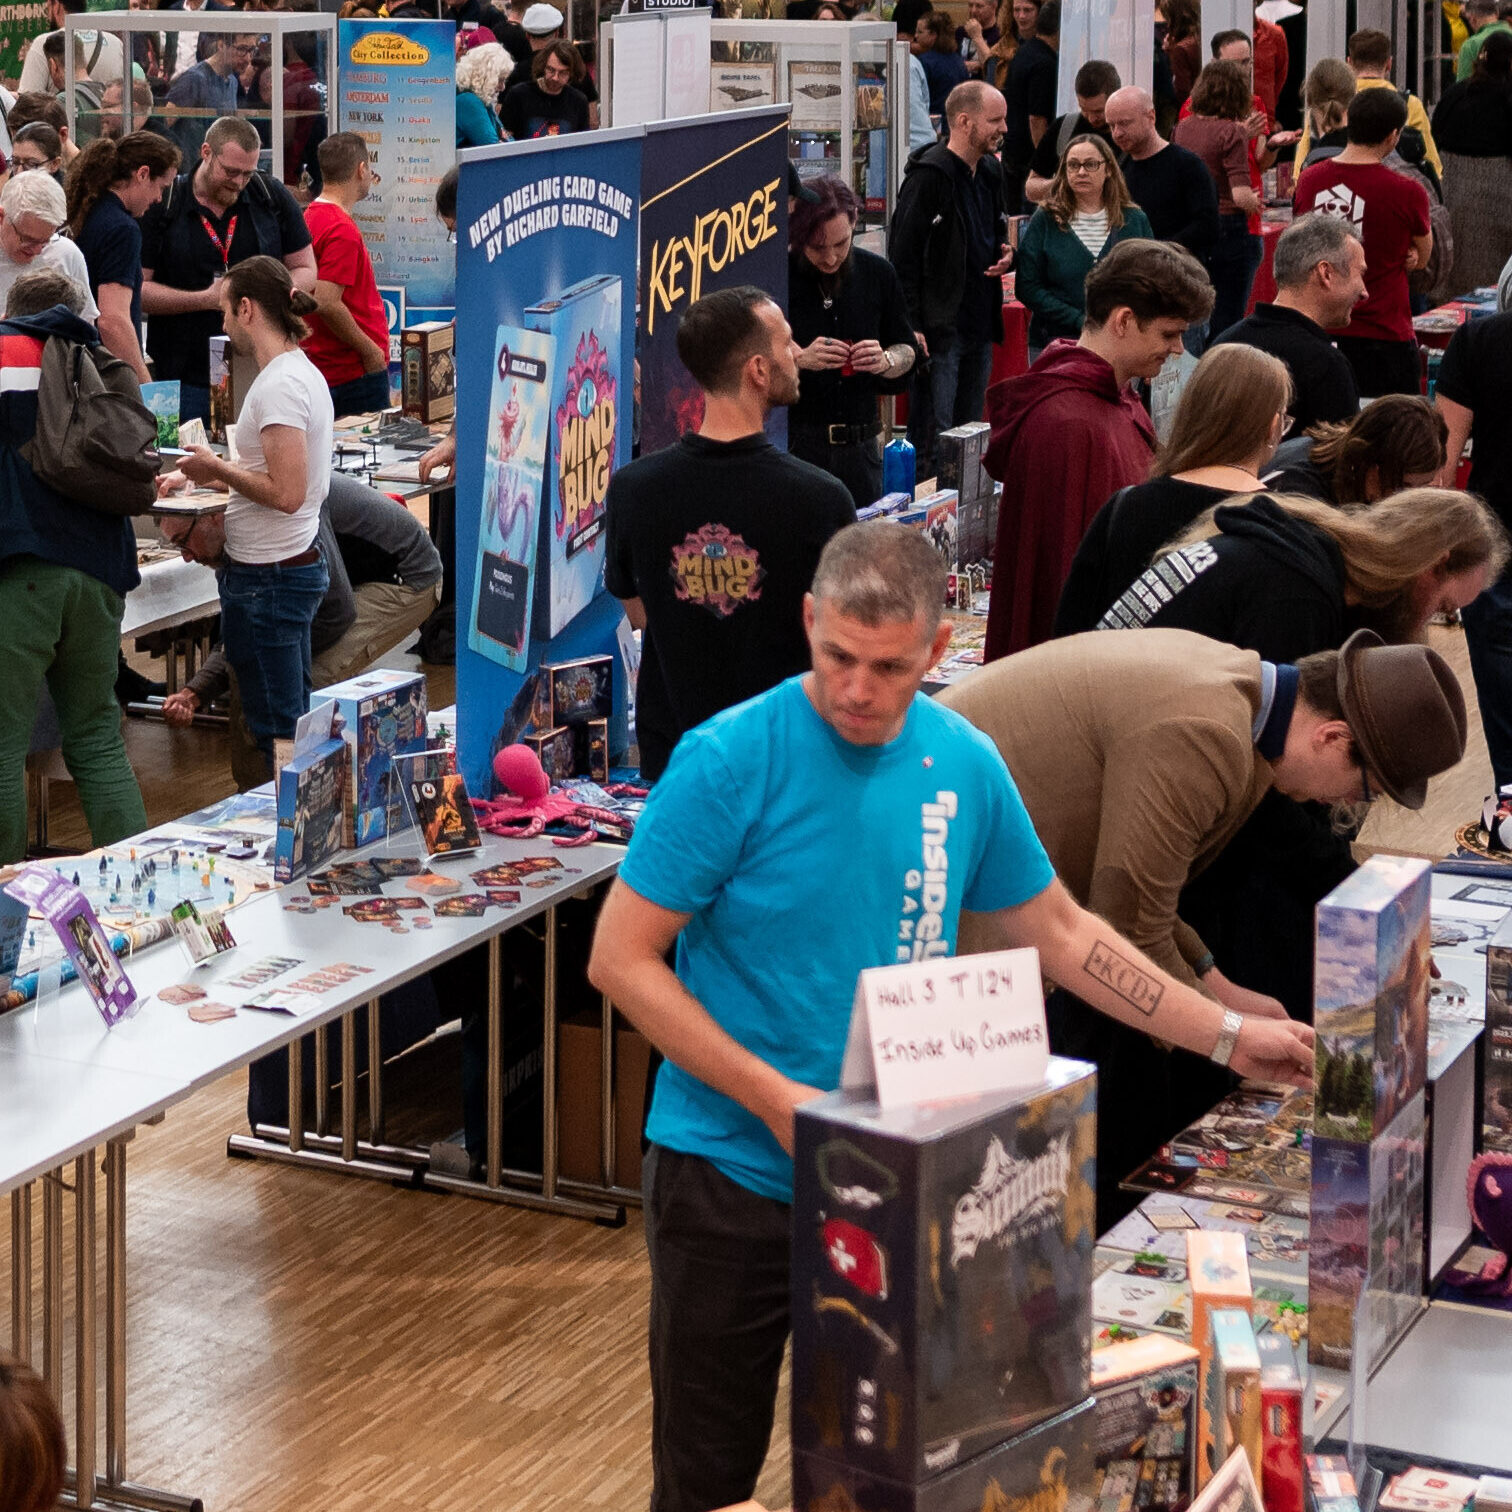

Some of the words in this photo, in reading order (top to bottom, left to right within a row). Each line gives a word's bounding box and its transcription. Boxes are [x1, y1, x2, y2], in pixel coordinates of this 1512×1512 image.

[352, 49, 367, 61] City
[370, 50, 425, 60] Collection
[348, 110, 361, 122] NEW
[363, 111, 384, 123] YORK
[408, 136, 441, 146] Kingston
[469, 202, 501, 249] NEW
[503, 176, 561, 220] DUELING
[563, 175, 596, 201] CARD
[597, 181, 633, 220] GAME
[485, 230, 503, 263] BY
[505, 203, 560, 248] RICHARD
[561, 203, 619, 238] GARFIELD
[648, 177, 781, 336] KEYFORGE
[558, 396, 616, 480] MIND
[563, 448, 611, 527] BUG
[678, 554, 756, 577] MIND
[686, 574, 750, 599] BUG
[878, 984, 914, 1010] Hall
[923, 977, 937, 1002] 3
[977, 968, 1013, 1000] 124
[878, 1036, 946, 1066] Inside
[950, 1030, 977, 1054] Up
[979, 1020, 1045, 1053] Games
